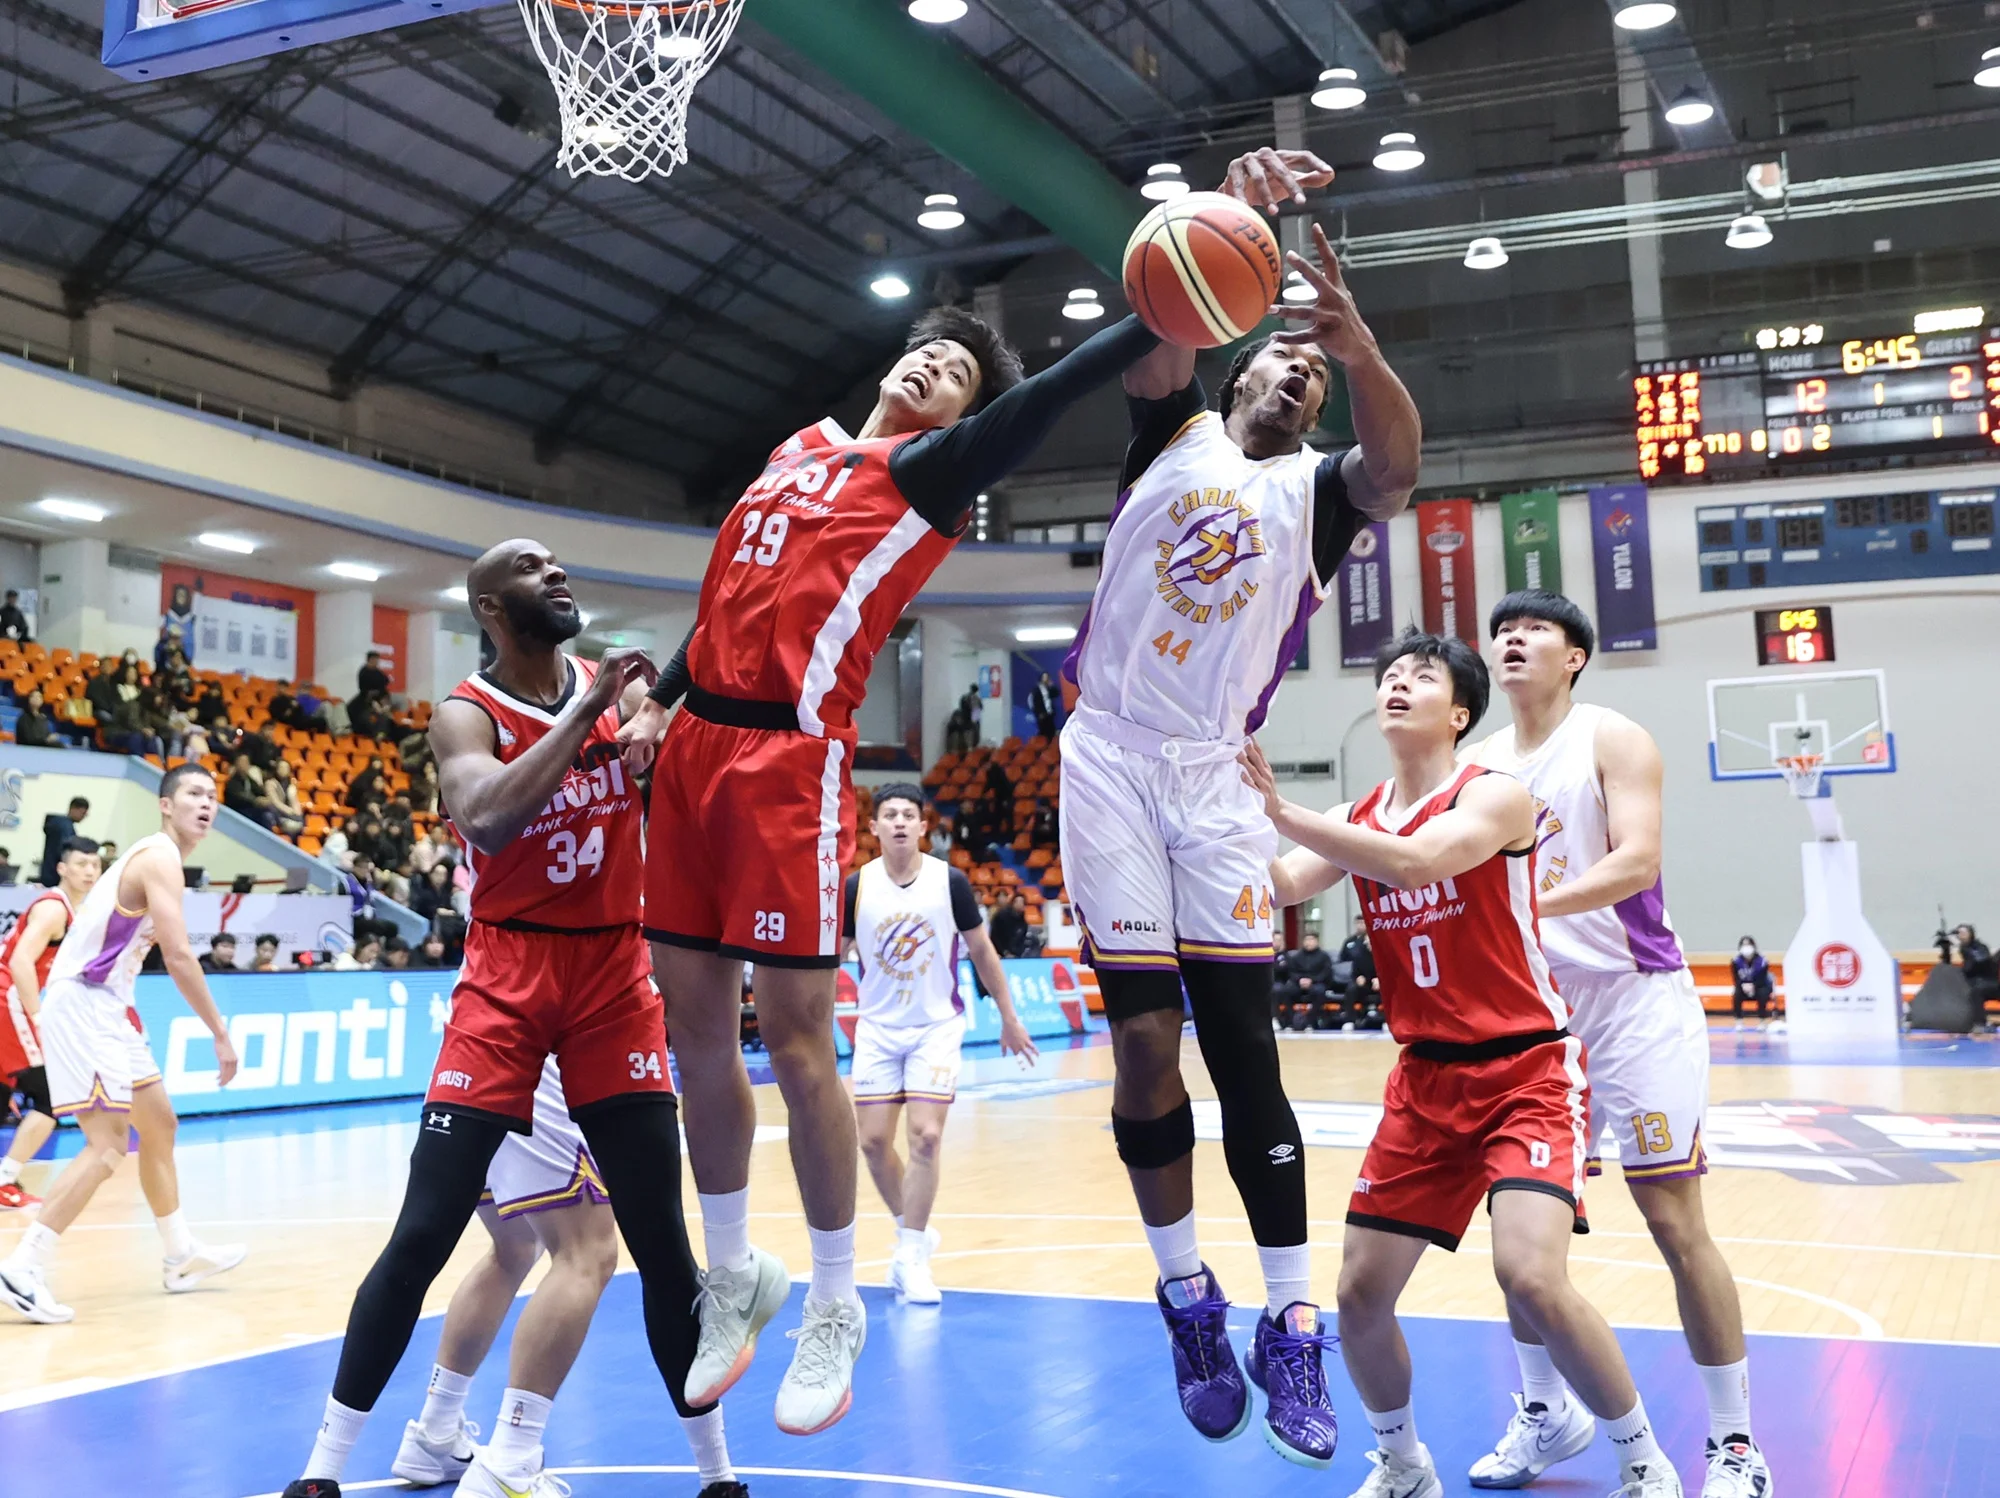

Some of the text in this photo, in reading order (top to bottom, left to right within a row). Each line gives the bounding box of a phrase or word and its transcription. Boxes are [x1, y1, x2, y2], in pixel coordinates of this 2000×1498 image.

[1842, 335, 1921, 374] 6:45
[1925, 336, 1974, 356] GUEST
[1768, 352, 1815, 371] HOME
[1796, 379, 1827, 413] 12
[1873, 382, 1884, 405] 1
[1949, 365, 1972, 399] 2
[1812, 424, 1831, 452] 2
[1932, 415, 1943, 439] 1
[1979, 411, 1989, 435] 1
[1782, 426, 1802, 453] 0
[733, 510, 790, 567] 29
[1612, 542, 1633, 590] YULON
[1219, 578, 1259, 624] BLL
[1152, 630, 1193, 666] 44
[1786, 632, 1815, 662] 16
[521, 815, 564, 839] BANK
[546, 826, 605, 884] 34
[754, 910, 786, 942] 29
[1402, 914, 1421, 929] OF
[1409, 934, 1440, 989] 0
[162, 979, 409, 1096] conti
[436, 1070, 472, 1090] TRUST
[628, 1051, 662, 1080] 34
[1631, 1111, 1674, 1156] 13
[1529, 1141, 1550, 1168] 0
